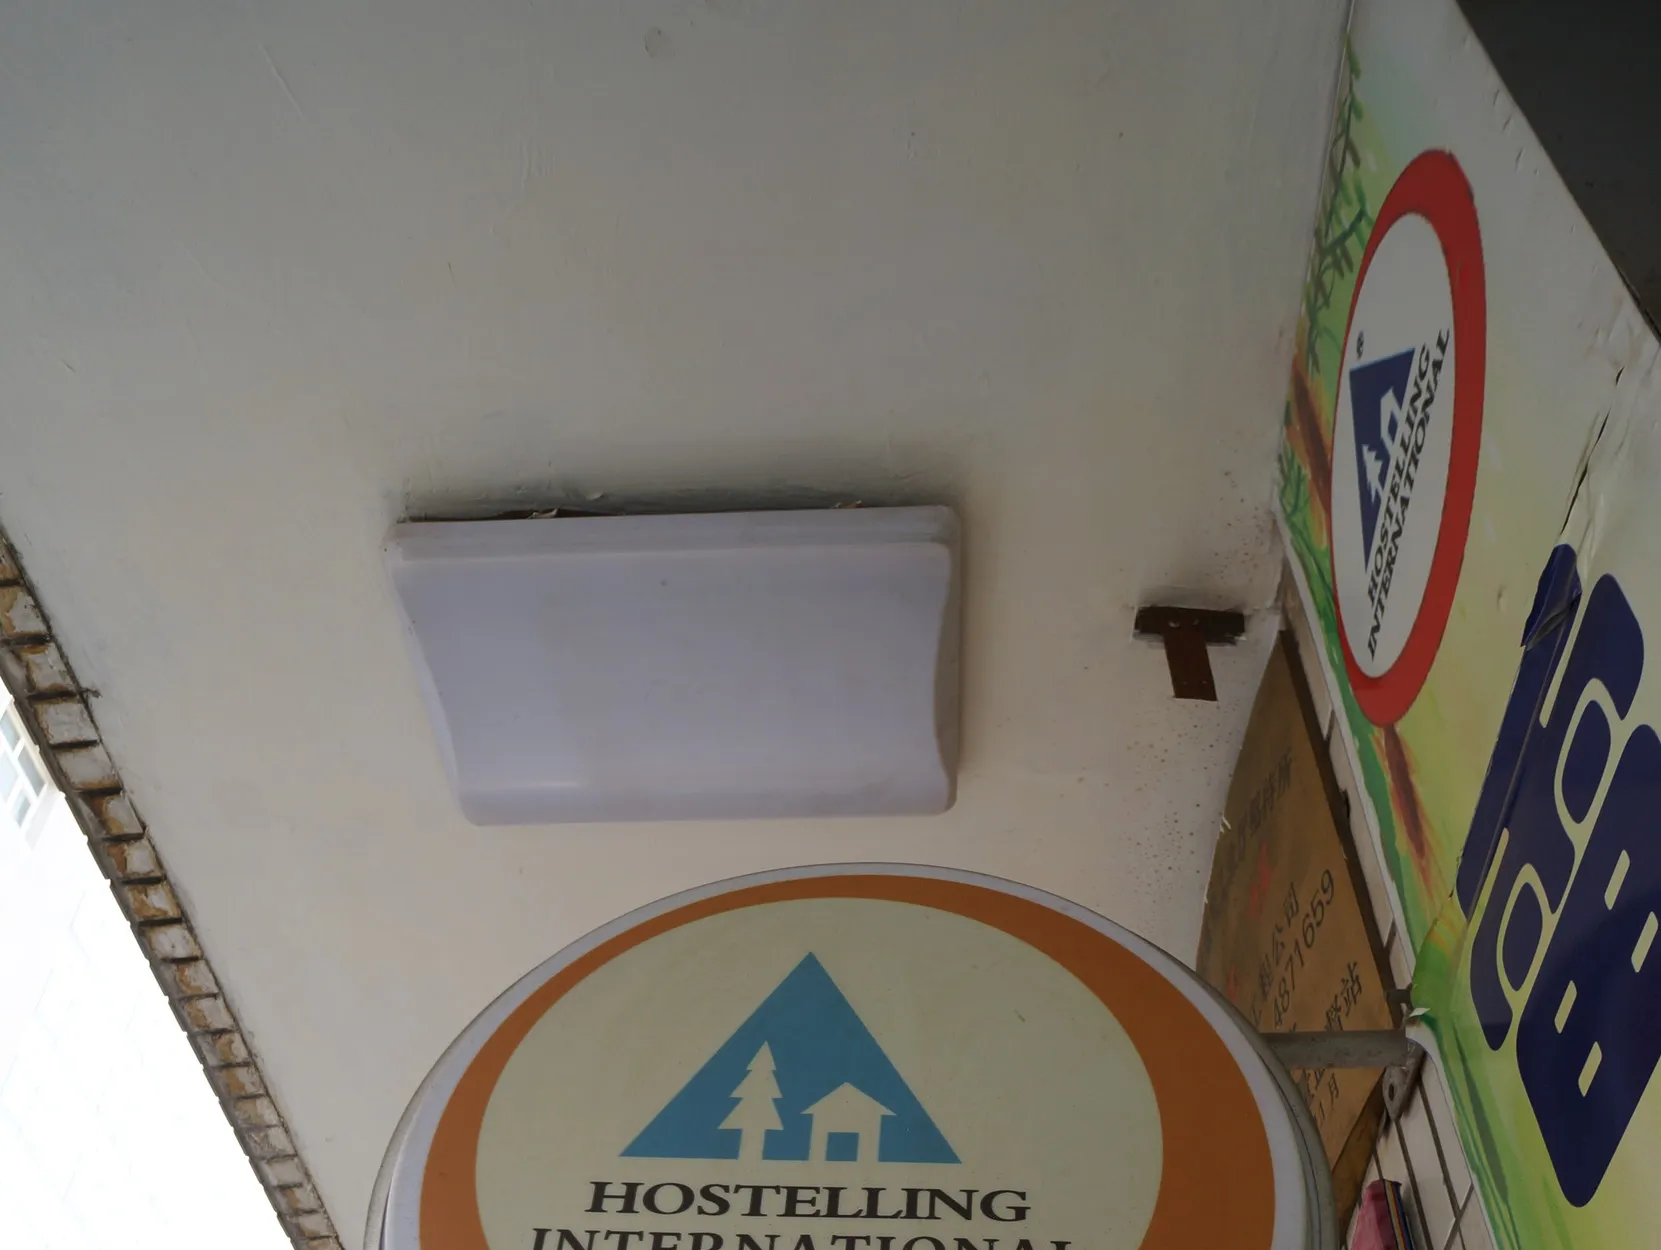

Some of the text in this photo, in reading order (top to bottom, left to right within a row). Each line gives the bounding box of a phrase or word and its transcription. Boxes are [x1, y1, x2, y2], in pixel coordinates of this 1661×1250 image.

[1367, 343, 1430, 608] HOSTELLING
[1367, 327, 1450, 664] INTERNATIONAL
[584, 1180, 1032, 1222] HOSTELLING
